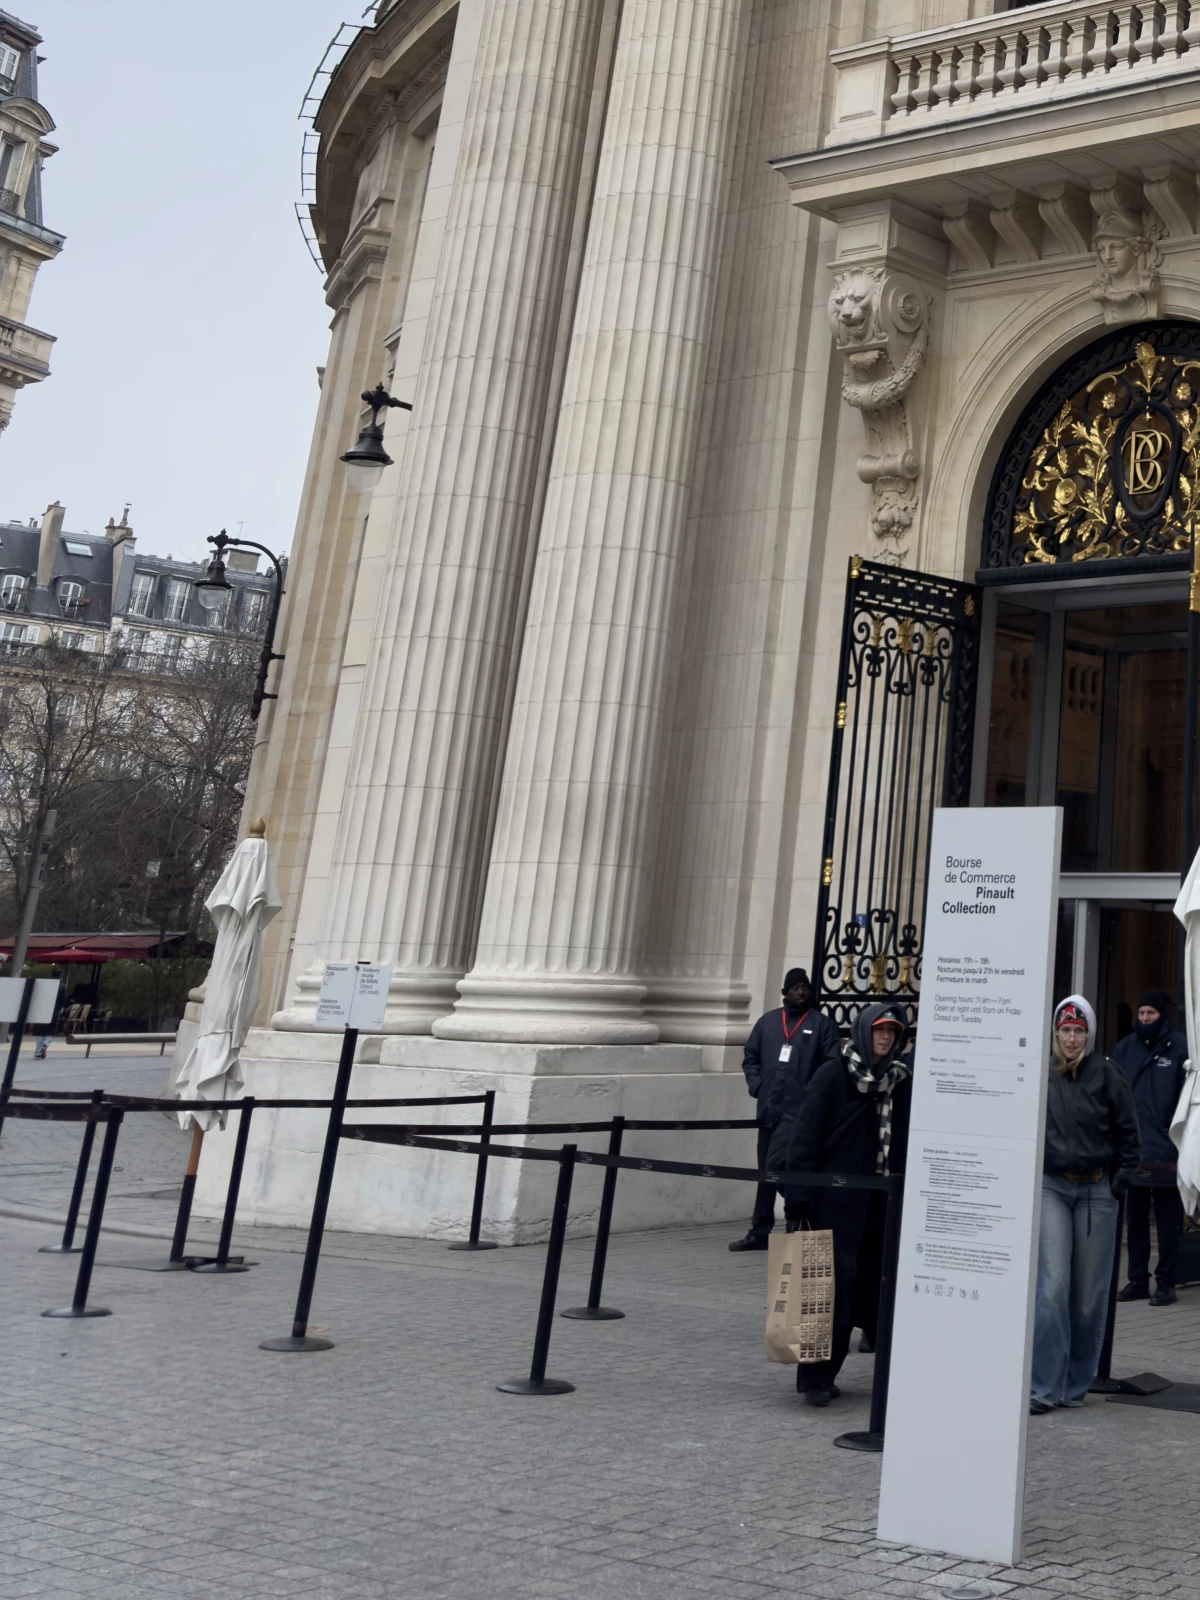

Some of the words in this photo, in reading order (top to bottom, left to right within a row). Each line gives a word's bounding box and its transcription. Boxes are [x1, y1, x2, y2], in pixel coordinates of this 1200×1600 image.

[945, 856, 982, 869] Bourse
[944, 871, 957, 884] de
[960, 871, 1016, 884] Commerce
[976, 886, 1015, 899] Pinault
[942, 901, 996, 914] Collection
[937, 966, 962, 974] Nocturne
[936, 975, 964, 983] Fermeture
[935, 994, 957, 1003] Opening
[934, 1004, 948, 1012] Open
[956, 1006, 970, 1014] night
[1006, 1007, 1022, 1016] Friday
[934, 1014, 952, 1022] Closed
[962, 1015, 982, 1024] Tuesday
[800, 1319, 808, 1358] REDUCE
